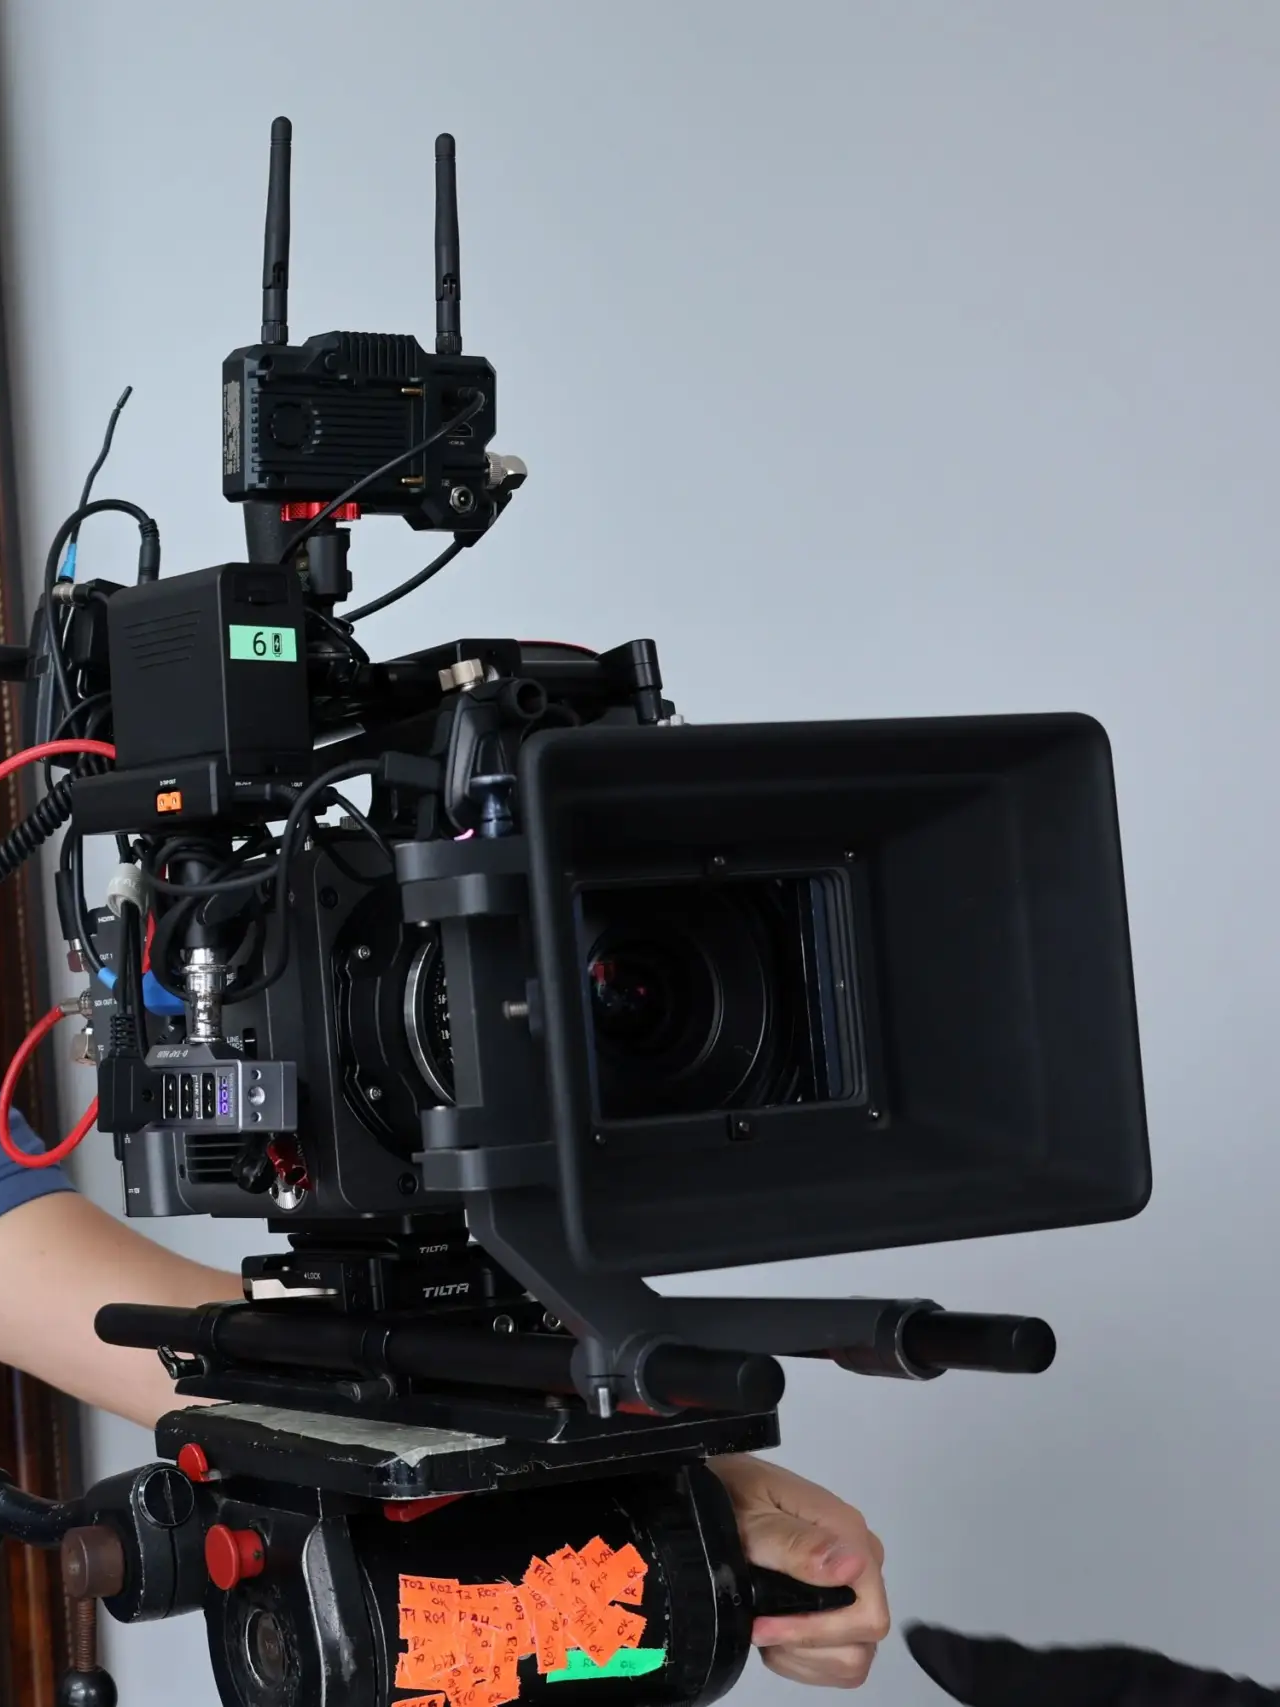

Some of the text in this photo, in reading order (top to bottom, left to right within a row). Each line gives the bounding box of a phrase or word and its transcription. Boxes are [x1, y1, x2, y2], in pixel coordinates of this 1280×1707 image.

[253, 631, 266, 656] 6
[226, 1035, 239, 1043] LINE
[420, 1244, 448, 1254] TILTA
[307, 1272, 321, 1280] LOCK
[423, 1282, 469, 1298] TILTA
